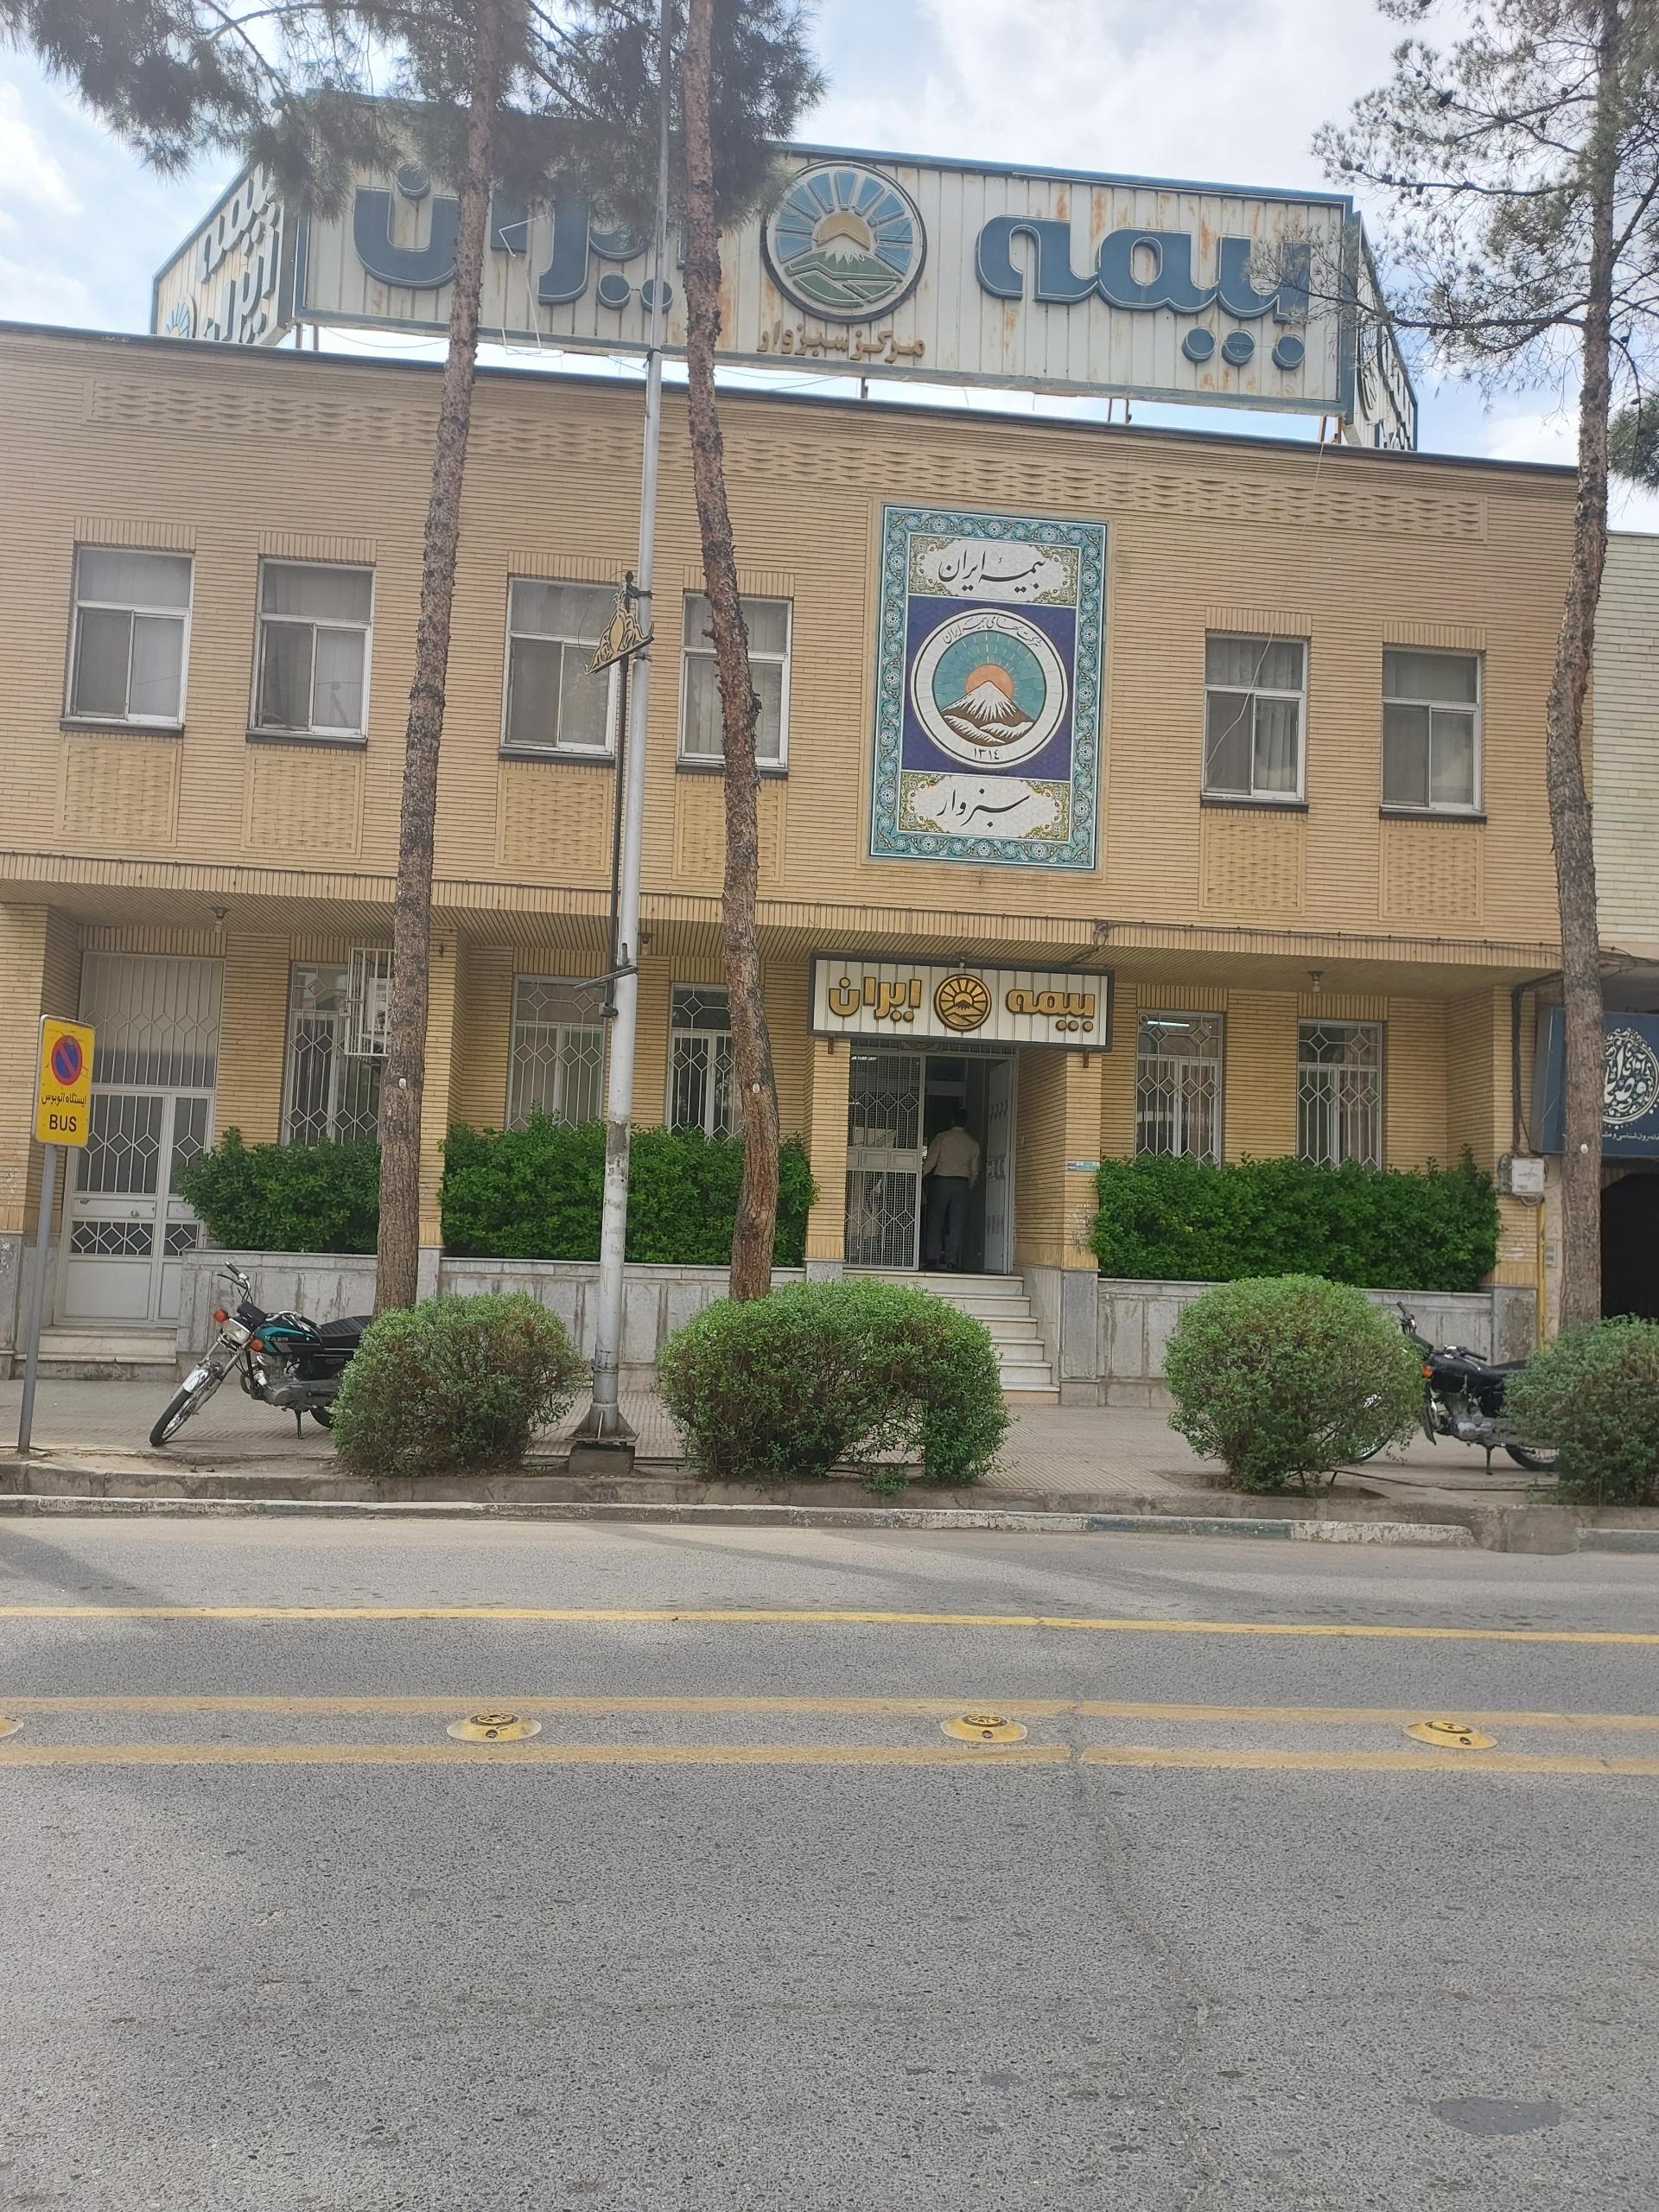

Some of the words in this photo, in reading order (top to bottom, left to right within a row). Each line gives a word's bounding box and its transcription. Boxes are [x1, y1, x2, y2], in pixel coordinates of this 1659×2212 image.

[976, 214, 1311, 371] بیمه
[757, 319, 849, 357] سبزوار
[850, 329, 925, 364] مرکز
[938, 549, 987, 591] ایران
[937, 787, 1031, 828] سبزوار
[828, 976, 922, 1023] ایران
[1006, 988, 1096, 1033] بیمه
[41, 1092, 65, 1106] اتوبوس
[66, 1092, 86, 1108] ایستگاه
[48, 1114, 77, 1133] BUS
